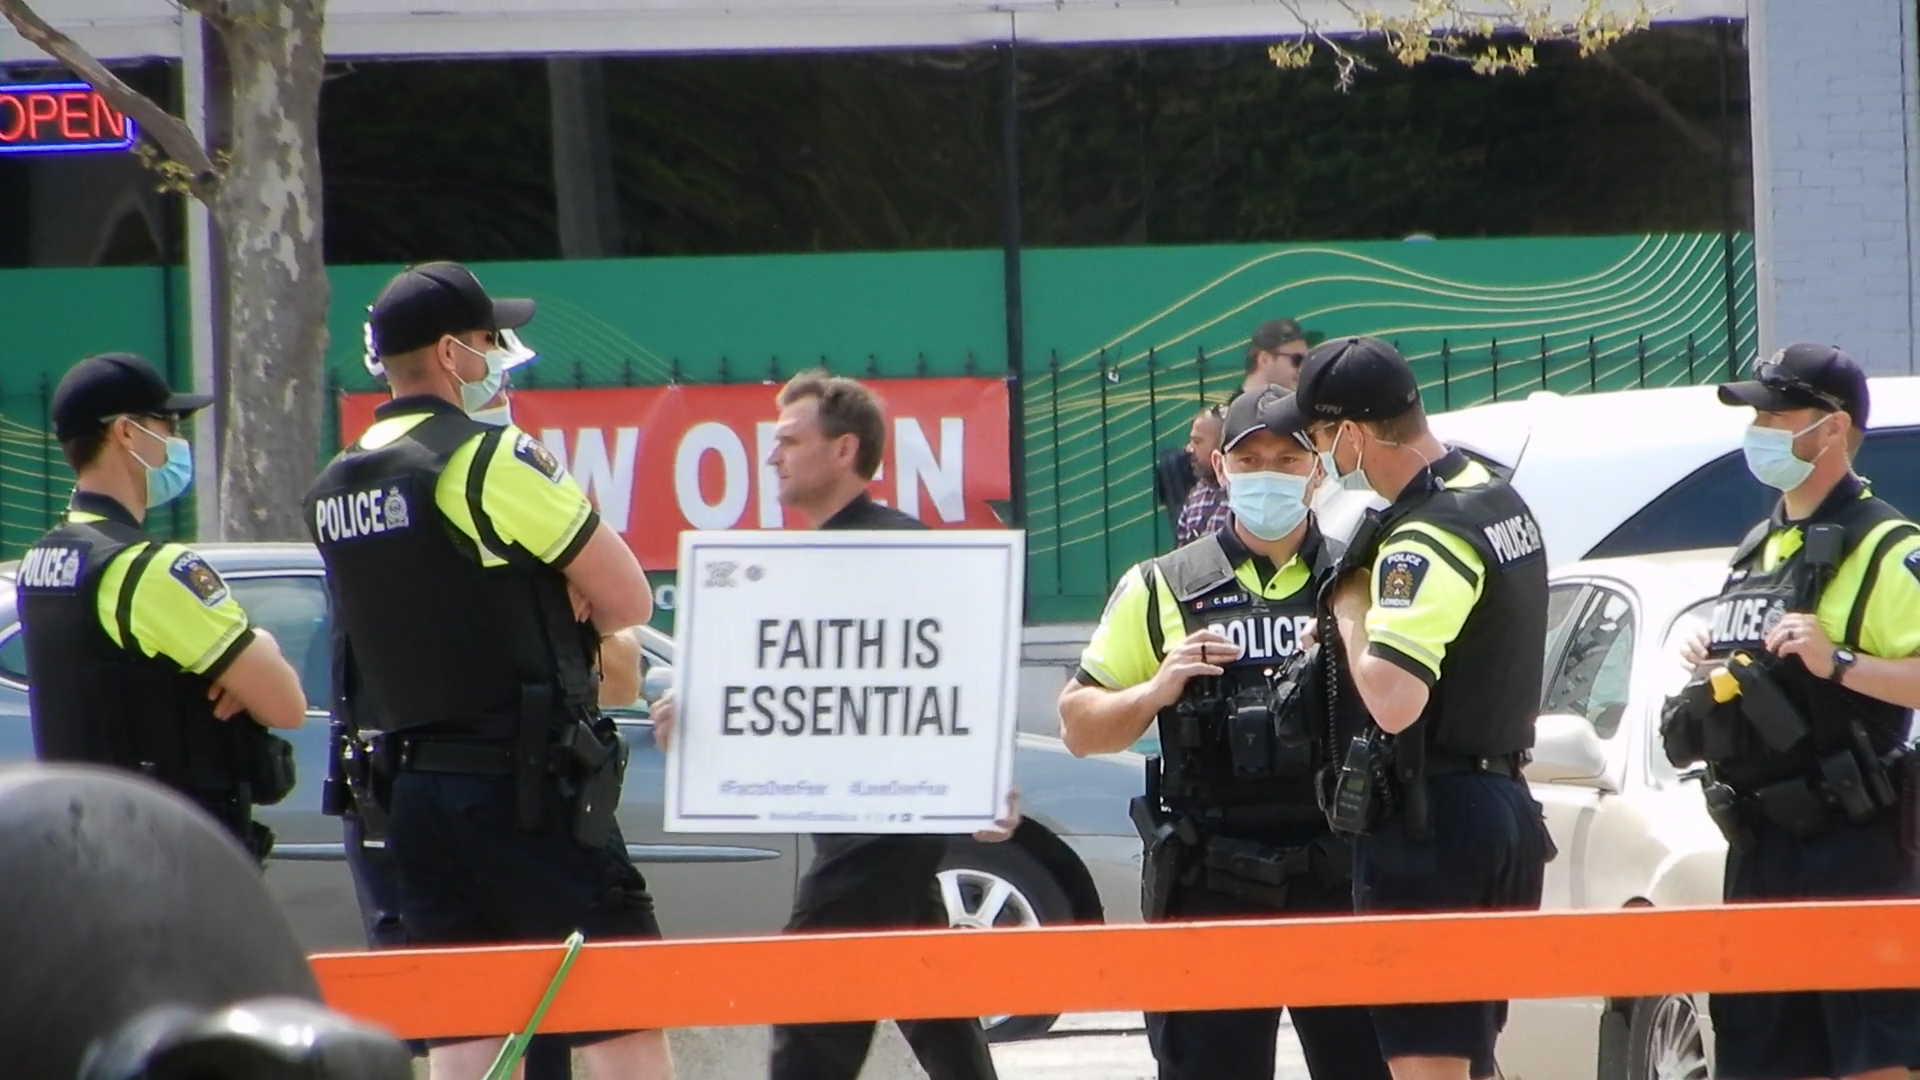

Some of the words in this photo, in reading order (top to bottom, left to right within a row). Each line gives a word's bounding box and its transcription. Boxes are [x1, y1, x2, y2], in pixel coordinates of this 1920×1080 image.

[0, 93, 124, 141] OPEN
[315, 488, 386, 543] POLICE
[1483, 514, 1532, 564] POLICE
[17, 547, 68, 587] POLICE
[1387, 553, 1423, 567] POLICE
[1380, 597, 1411, 607] LONDON
[757, 618, 886, 669] FAITH
[902, 618, 941, 669] IS
[722, 685, 971, 736] ESSENTIAL
